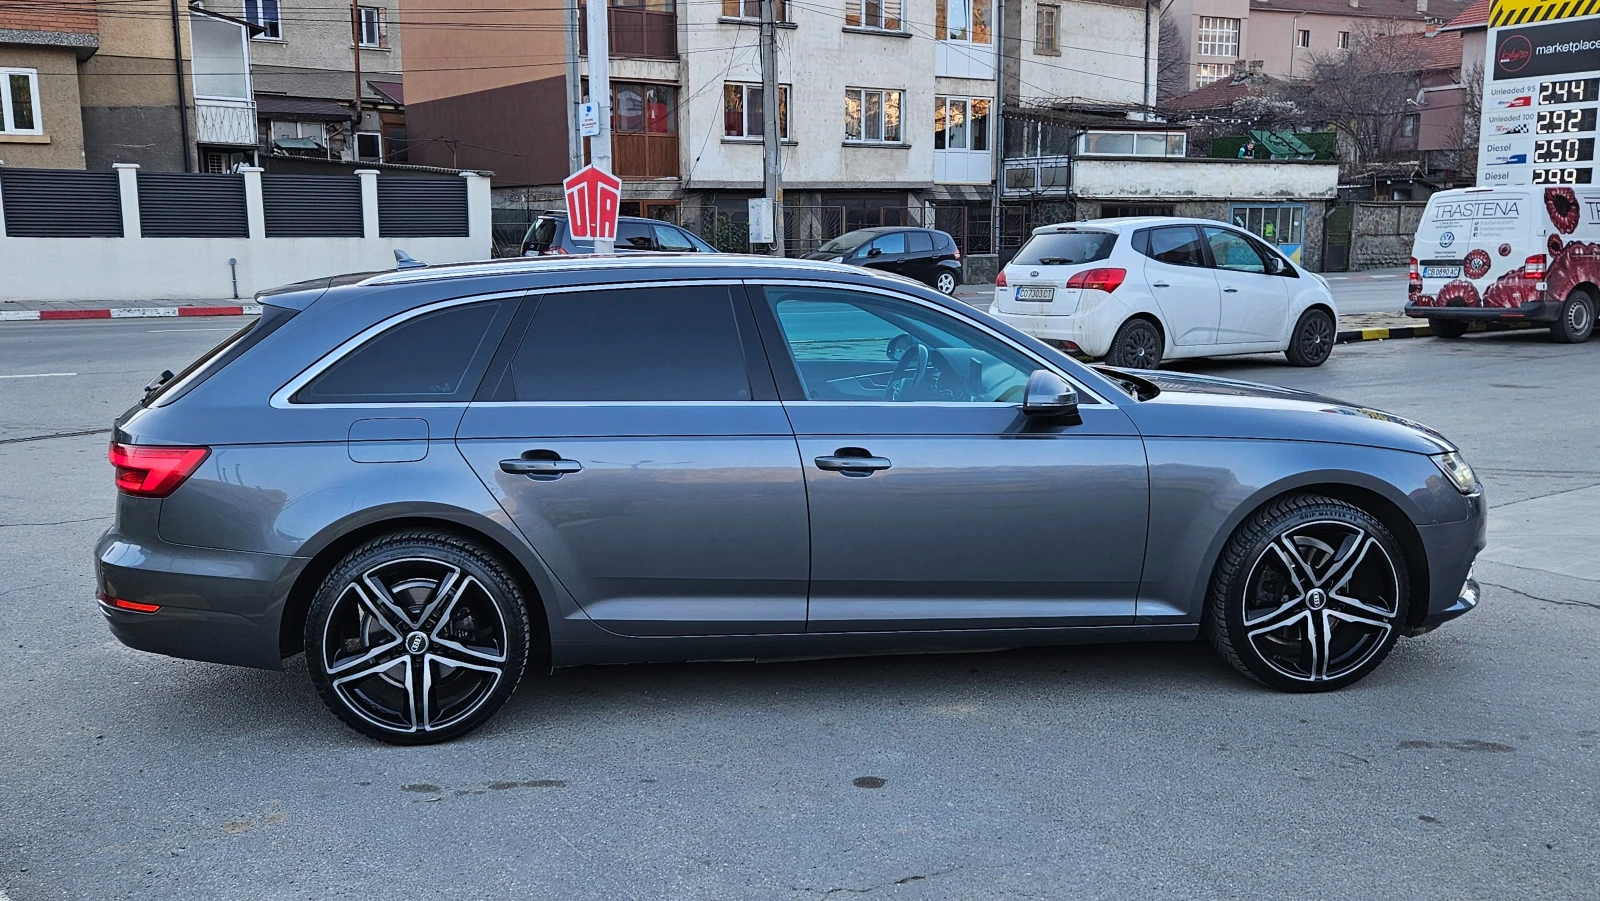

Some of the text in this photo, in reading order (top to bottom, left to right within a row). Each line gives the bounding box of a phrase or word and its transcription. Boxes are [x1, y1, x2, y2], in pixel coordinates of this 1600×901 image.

[1491, 85, 1536, 96] Unleaded 95
[1539, 80, 1584, 105] 2.44
[1489, 113, 1535, 123] Unleaded 100
[1536, 109, 1582, 133] 2.92
[1486, 143, 1512, 152] Diesel
[1534, 138, 1579, 163] 2.50
[1485, 171, 1510, 180] Diesel
[565, 166, 620, 239] UTA
[1435, 202, 1520, 219] TRASTENA
